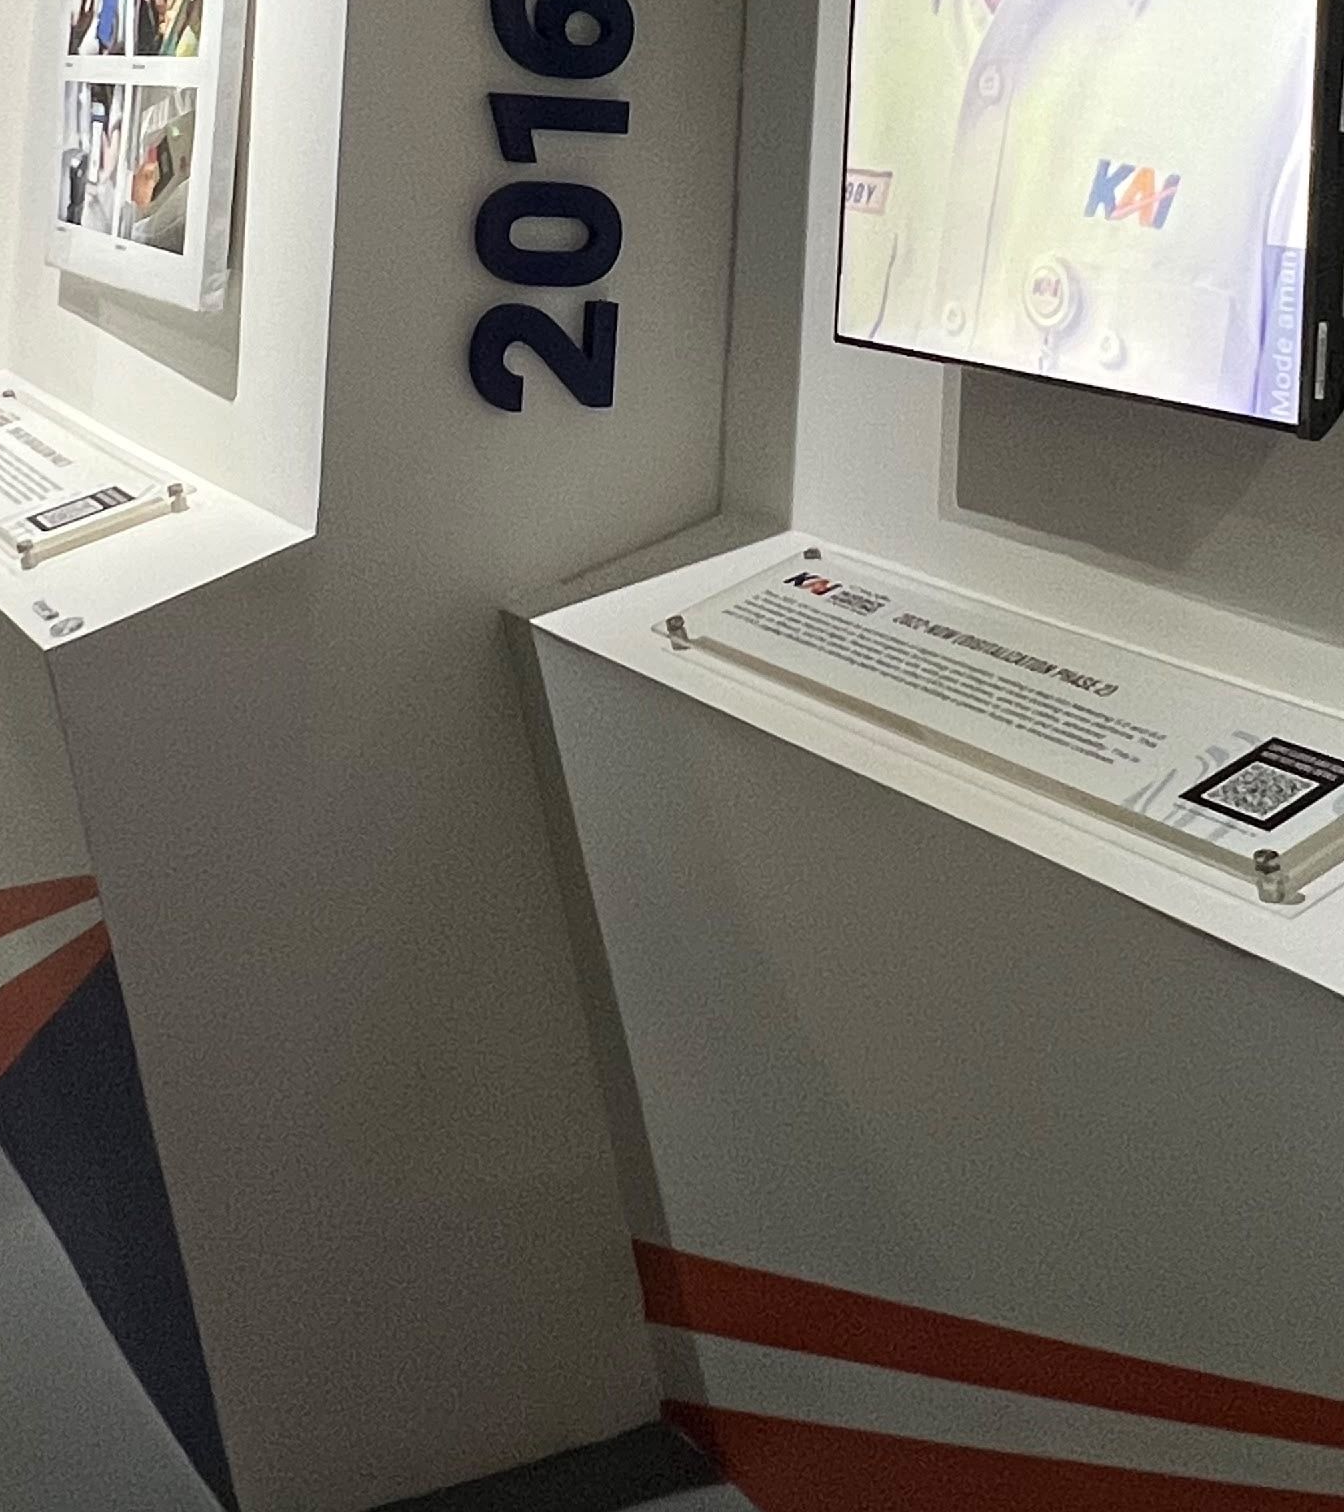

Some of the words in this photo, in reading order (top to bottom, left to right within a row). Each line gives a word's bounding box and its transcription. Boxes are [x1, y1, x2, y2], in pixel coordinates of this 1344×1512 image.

[1083, 158, 1181, 229] KAI
[1278, 249, 1298, 330] aman
[1269, 337, 1294, 418] Mode
